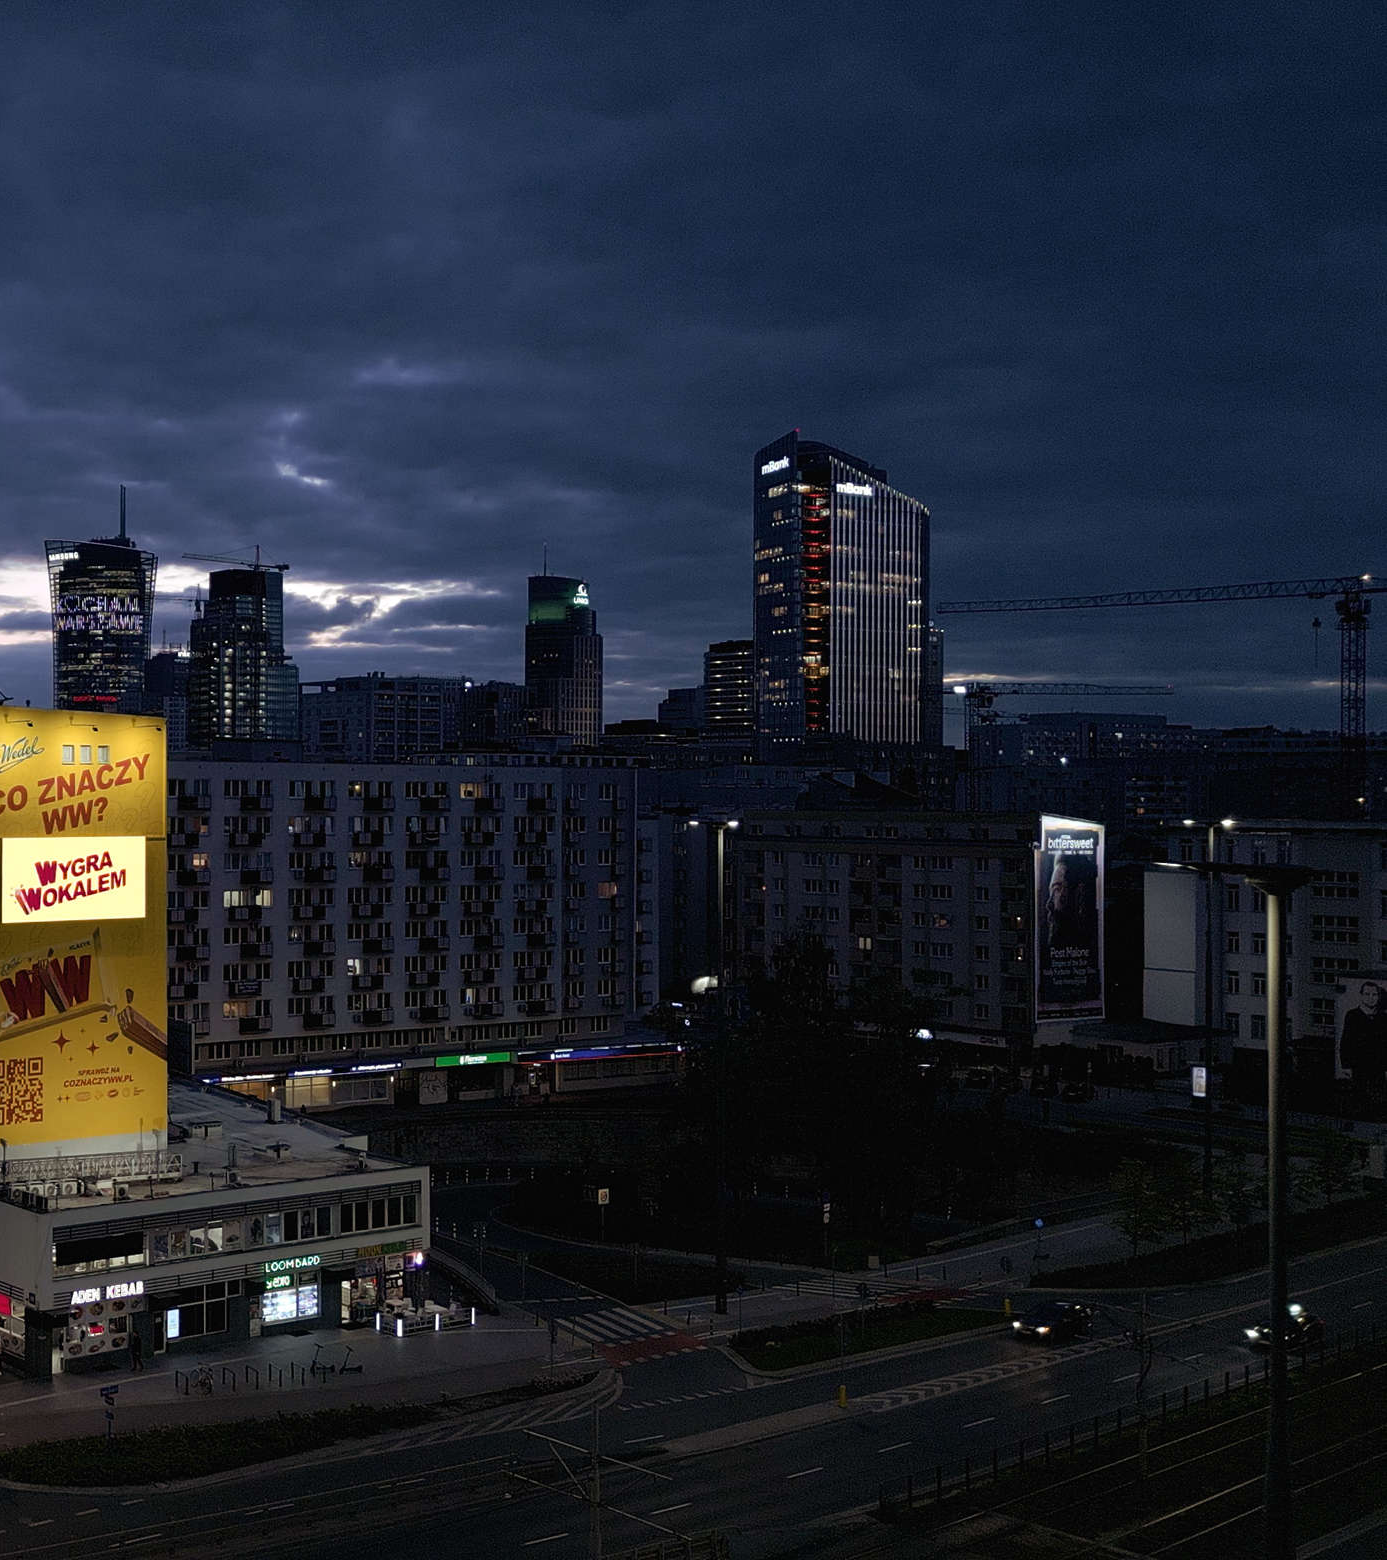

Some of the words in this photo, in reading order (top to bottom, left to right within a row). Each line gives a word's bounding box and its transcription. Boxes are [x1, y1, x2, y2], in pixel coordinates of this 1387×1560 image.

[761, 456, 790, 475] mBank
[836, 482, 873, 496] mBank
[37, 753, 151, 805] ZNACZY
[41, 796, 109, 836] WW?
[1047, 837, 1094, 849] bittersweet
[34, 850, 114, 887] WYGRA
[15, 868, 127, 915] WOKALEM
[68, 940, 92, 951] KLASYK
[110, 1066, 121, 1075] NA
[63, 1074, 134, 1088] COZNACZYWW.PL
[265, 1255, 321, 1273] LOOMBARD
[70, 1288, 101, 1305] ADEN
[105, 1280, 144, 1299] KEBAB
